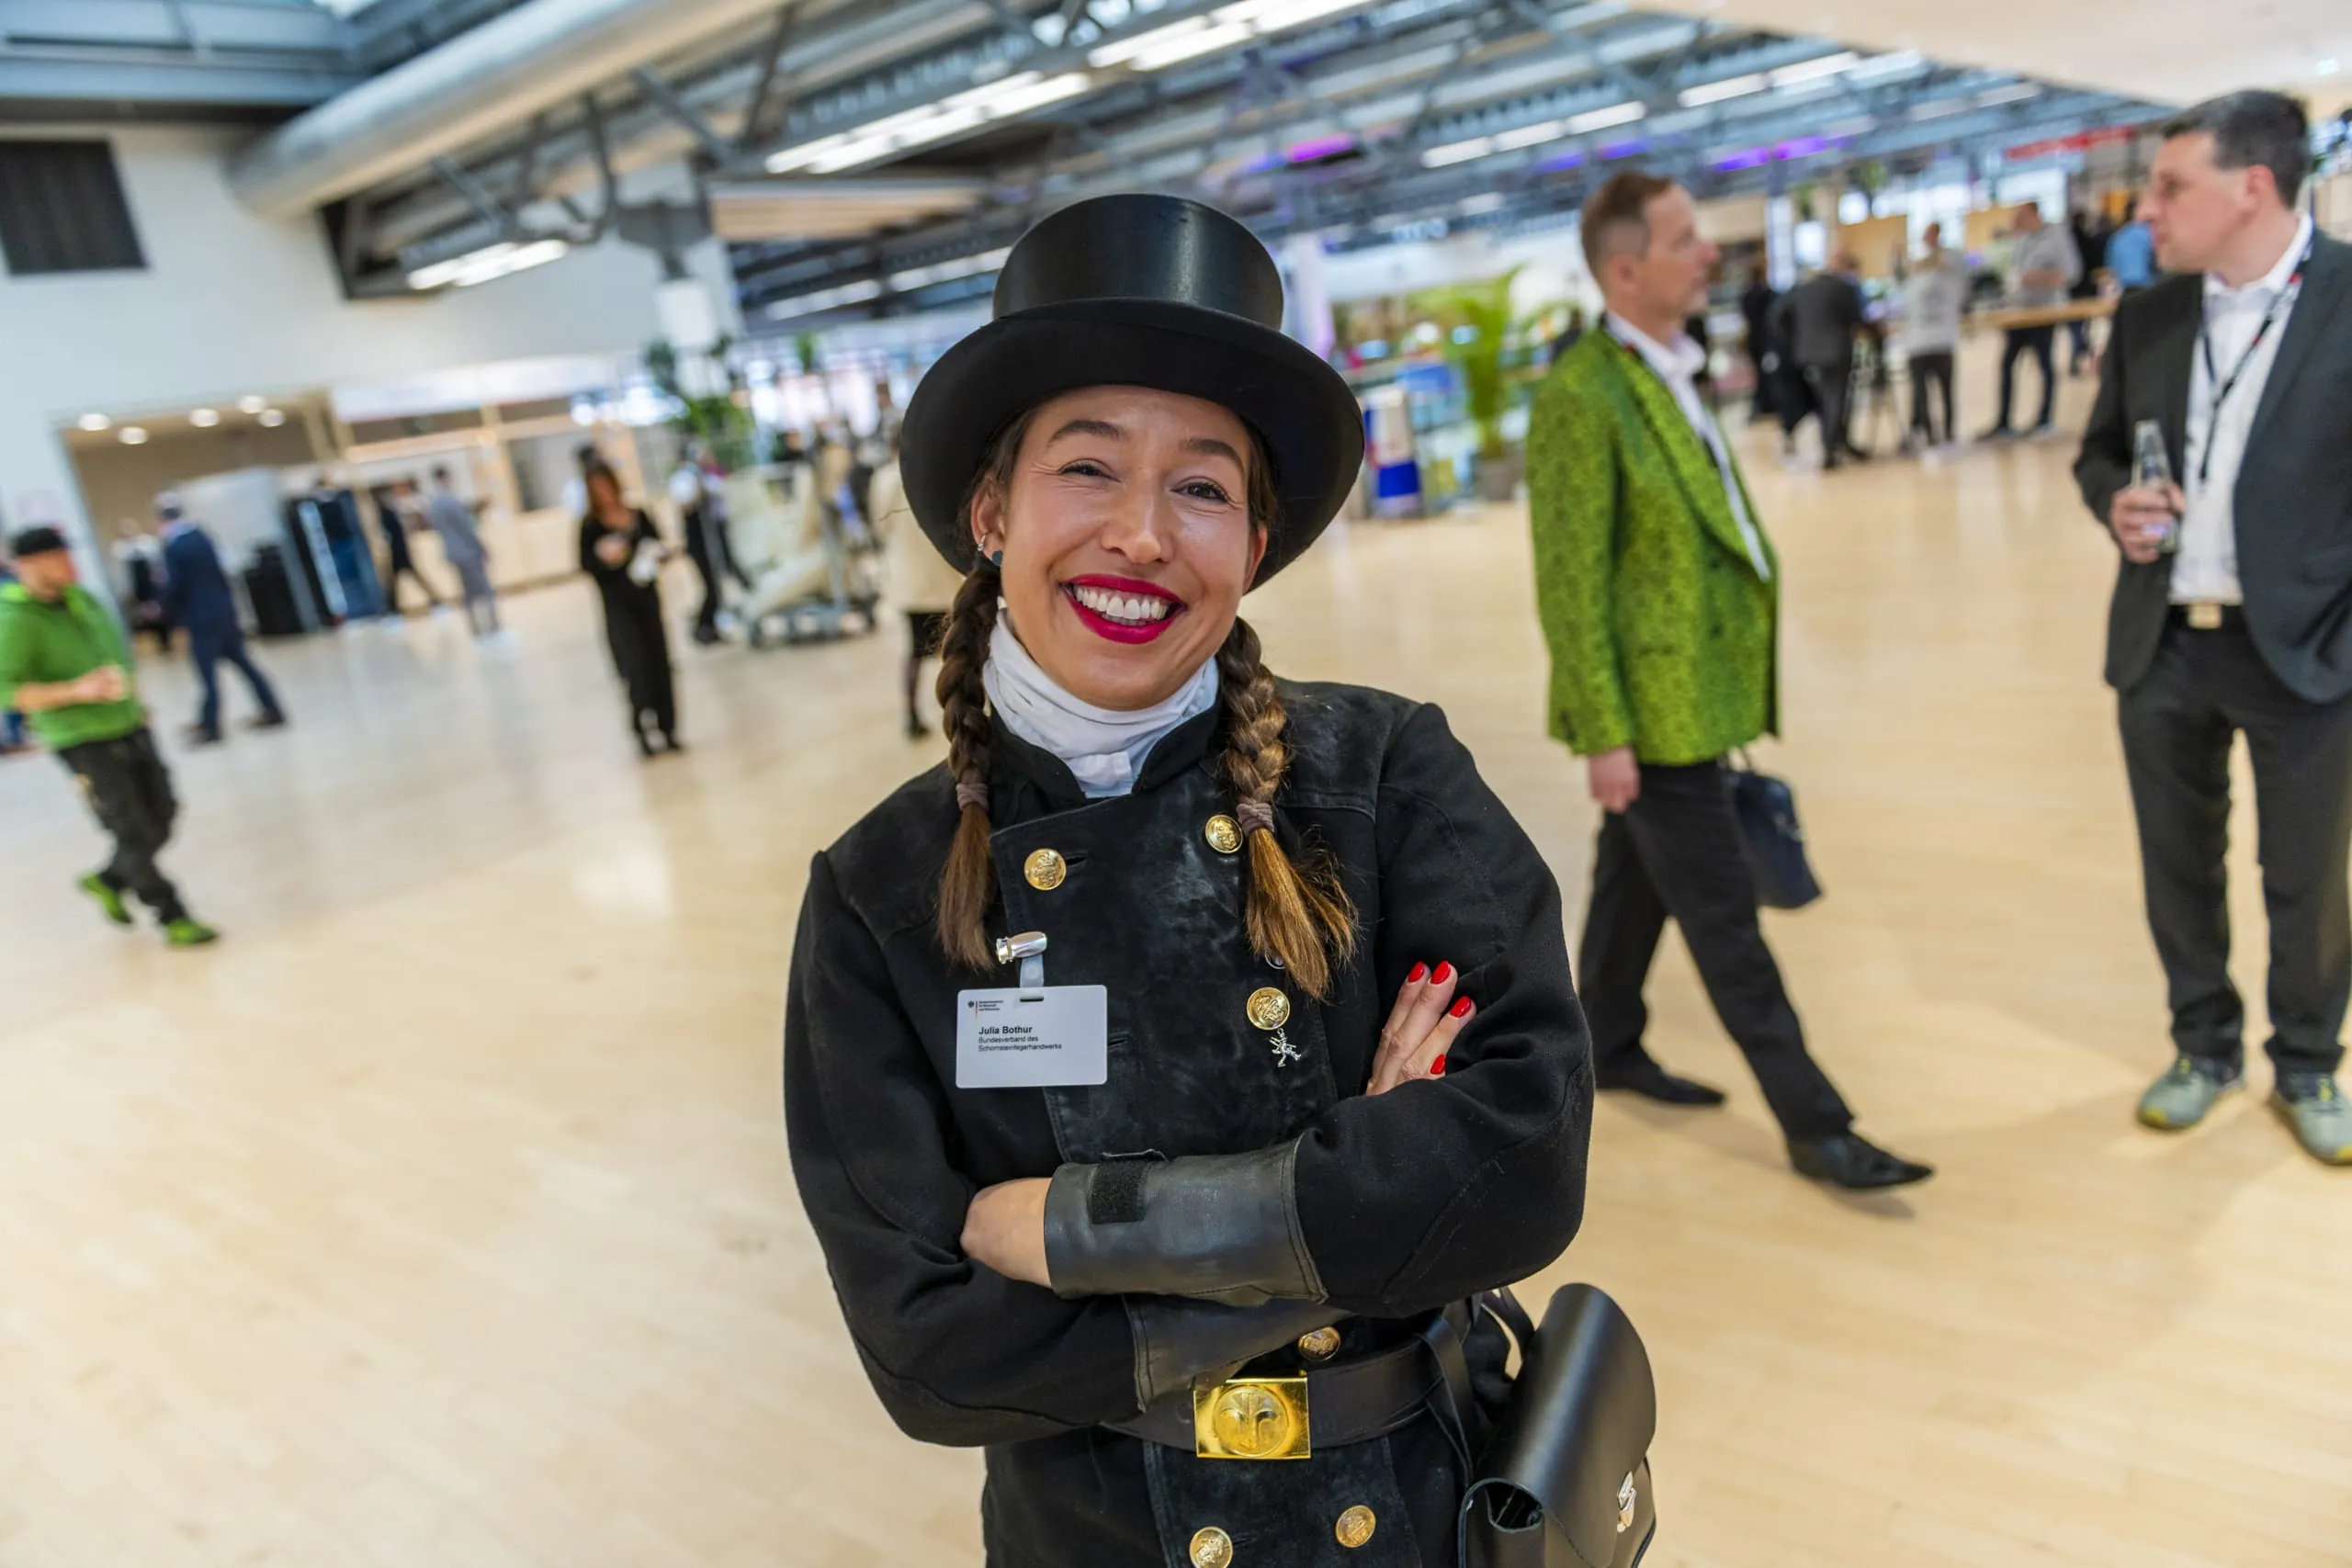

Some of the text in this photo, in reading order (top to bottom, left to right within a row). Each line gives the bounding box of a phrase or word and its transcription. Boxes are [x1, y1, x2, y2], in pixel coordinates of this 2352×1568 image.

[978, 1026, 1033, 1035] Julia Bothur
[978, 1043, 1062, 1052] Schornsteinfegerhandwerks
